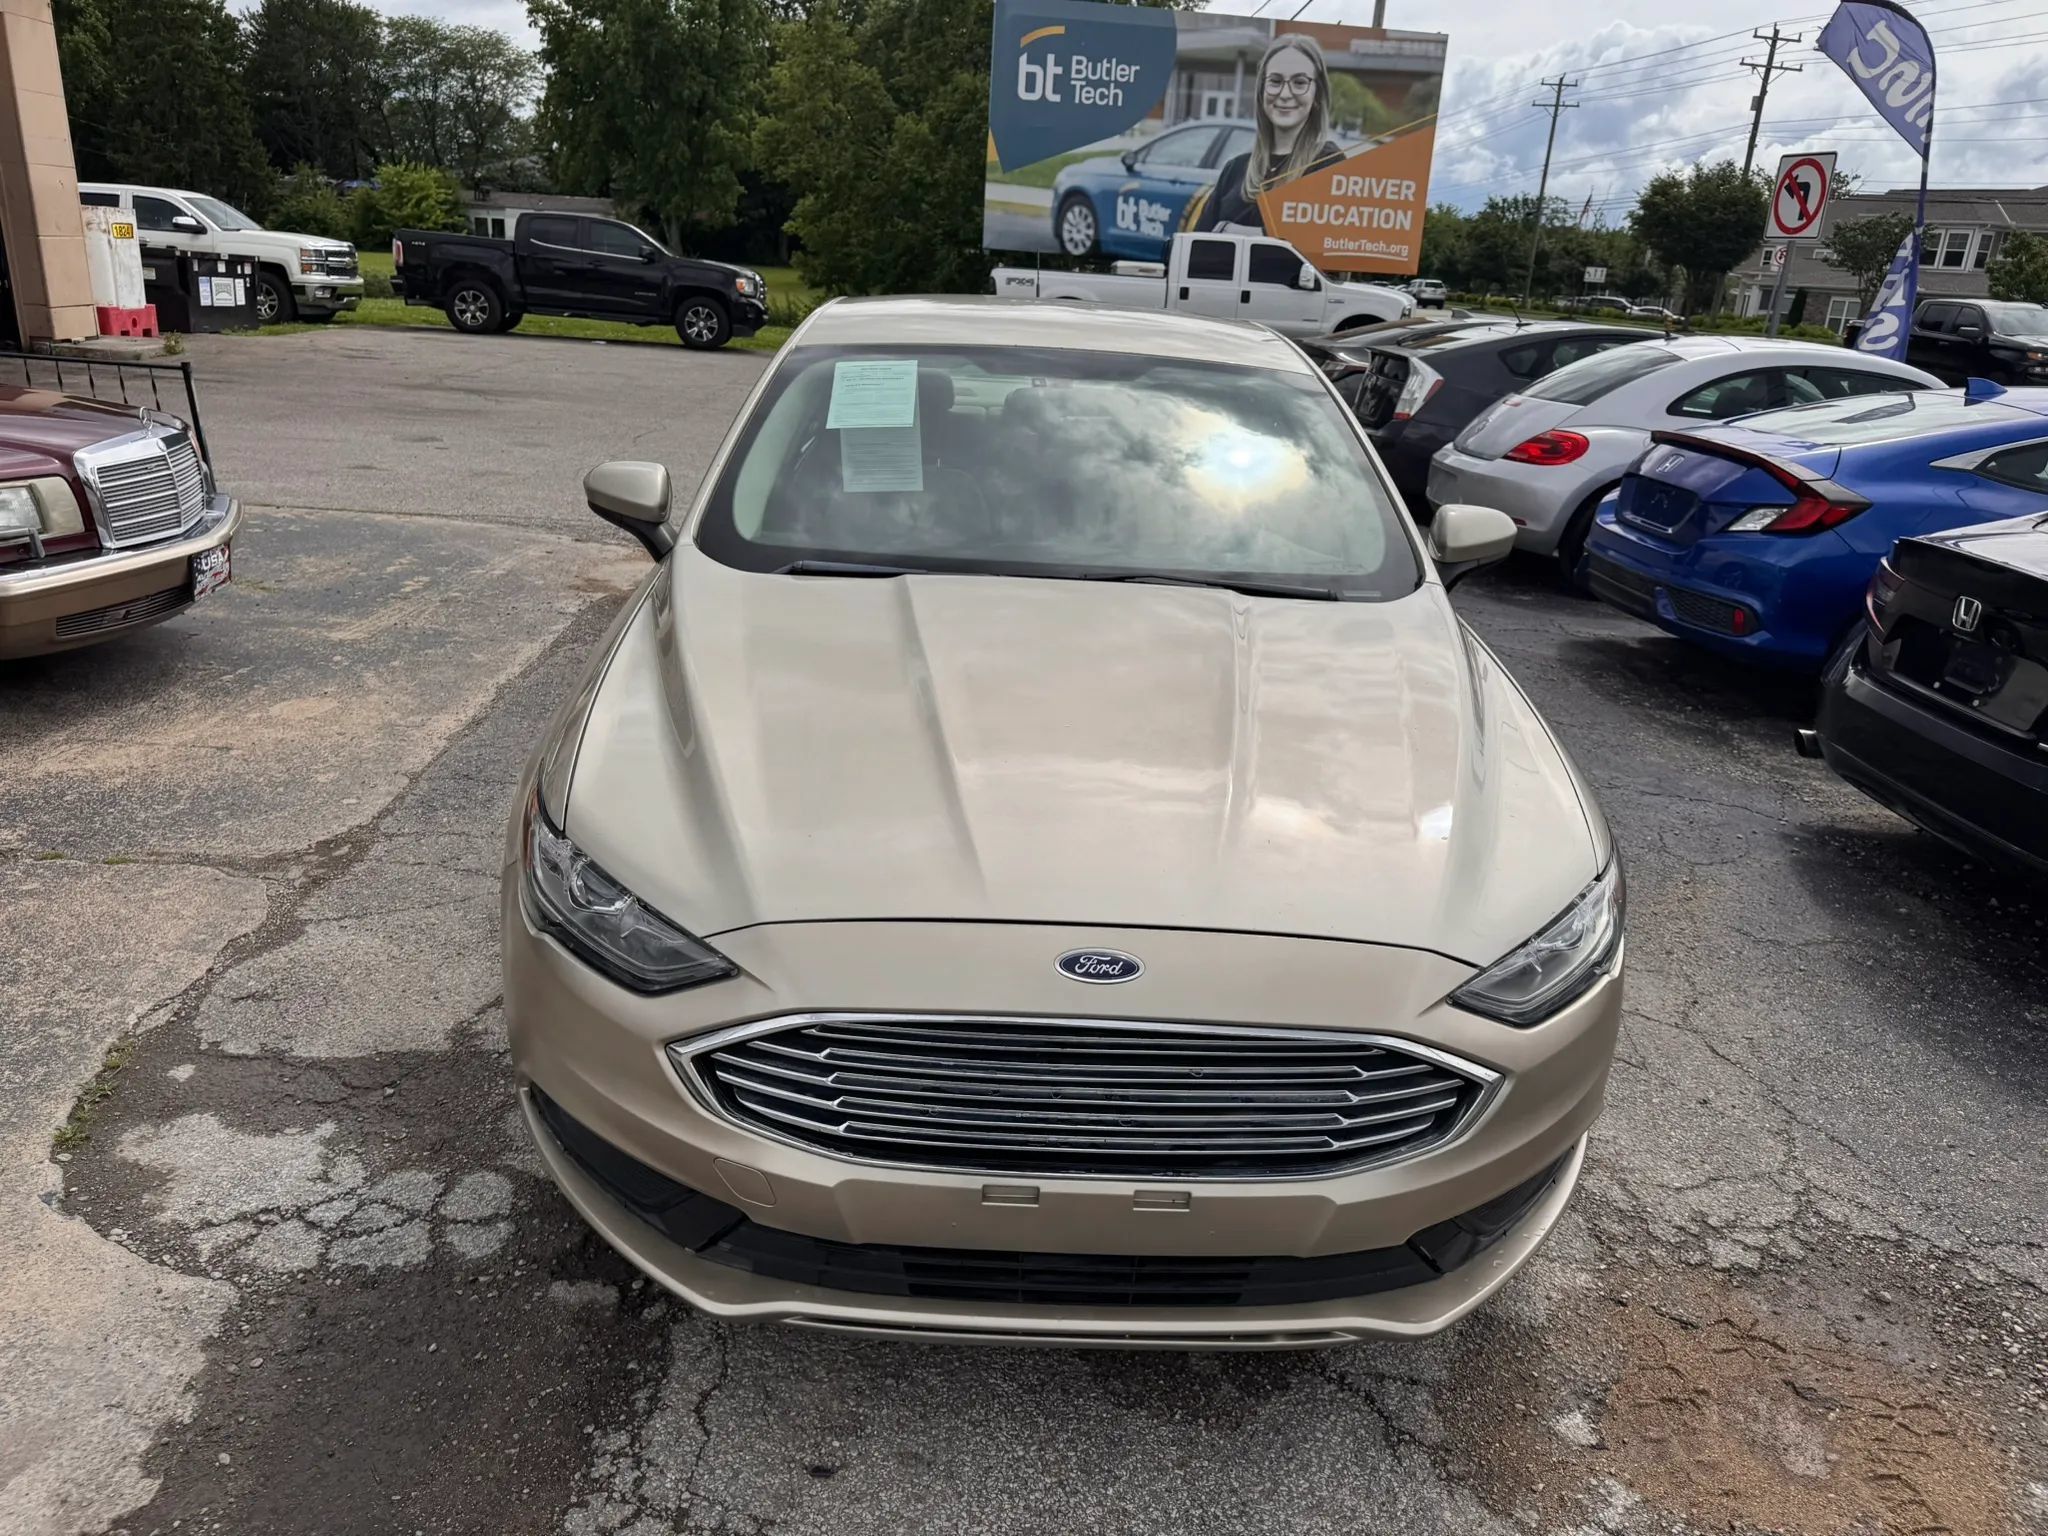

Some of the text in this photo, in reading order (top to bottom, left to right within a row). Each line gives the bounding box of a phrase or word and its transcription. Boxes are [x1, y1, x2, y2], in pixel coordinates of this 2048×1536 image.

[1017, 52, 1063, 102] bt
[1070, 55, 1140, 83] Butler
[1070, 80, 1123, 106] Tech
[1330, 174, 1416, 201] DRIVER
[1281, 201, 1413, 231] EDUCATION
[1323, 237, 1409, 256] ButlerTech.org
[201, 551, 224, 570] USA
[1075, 955, 1124, 975] Ford
